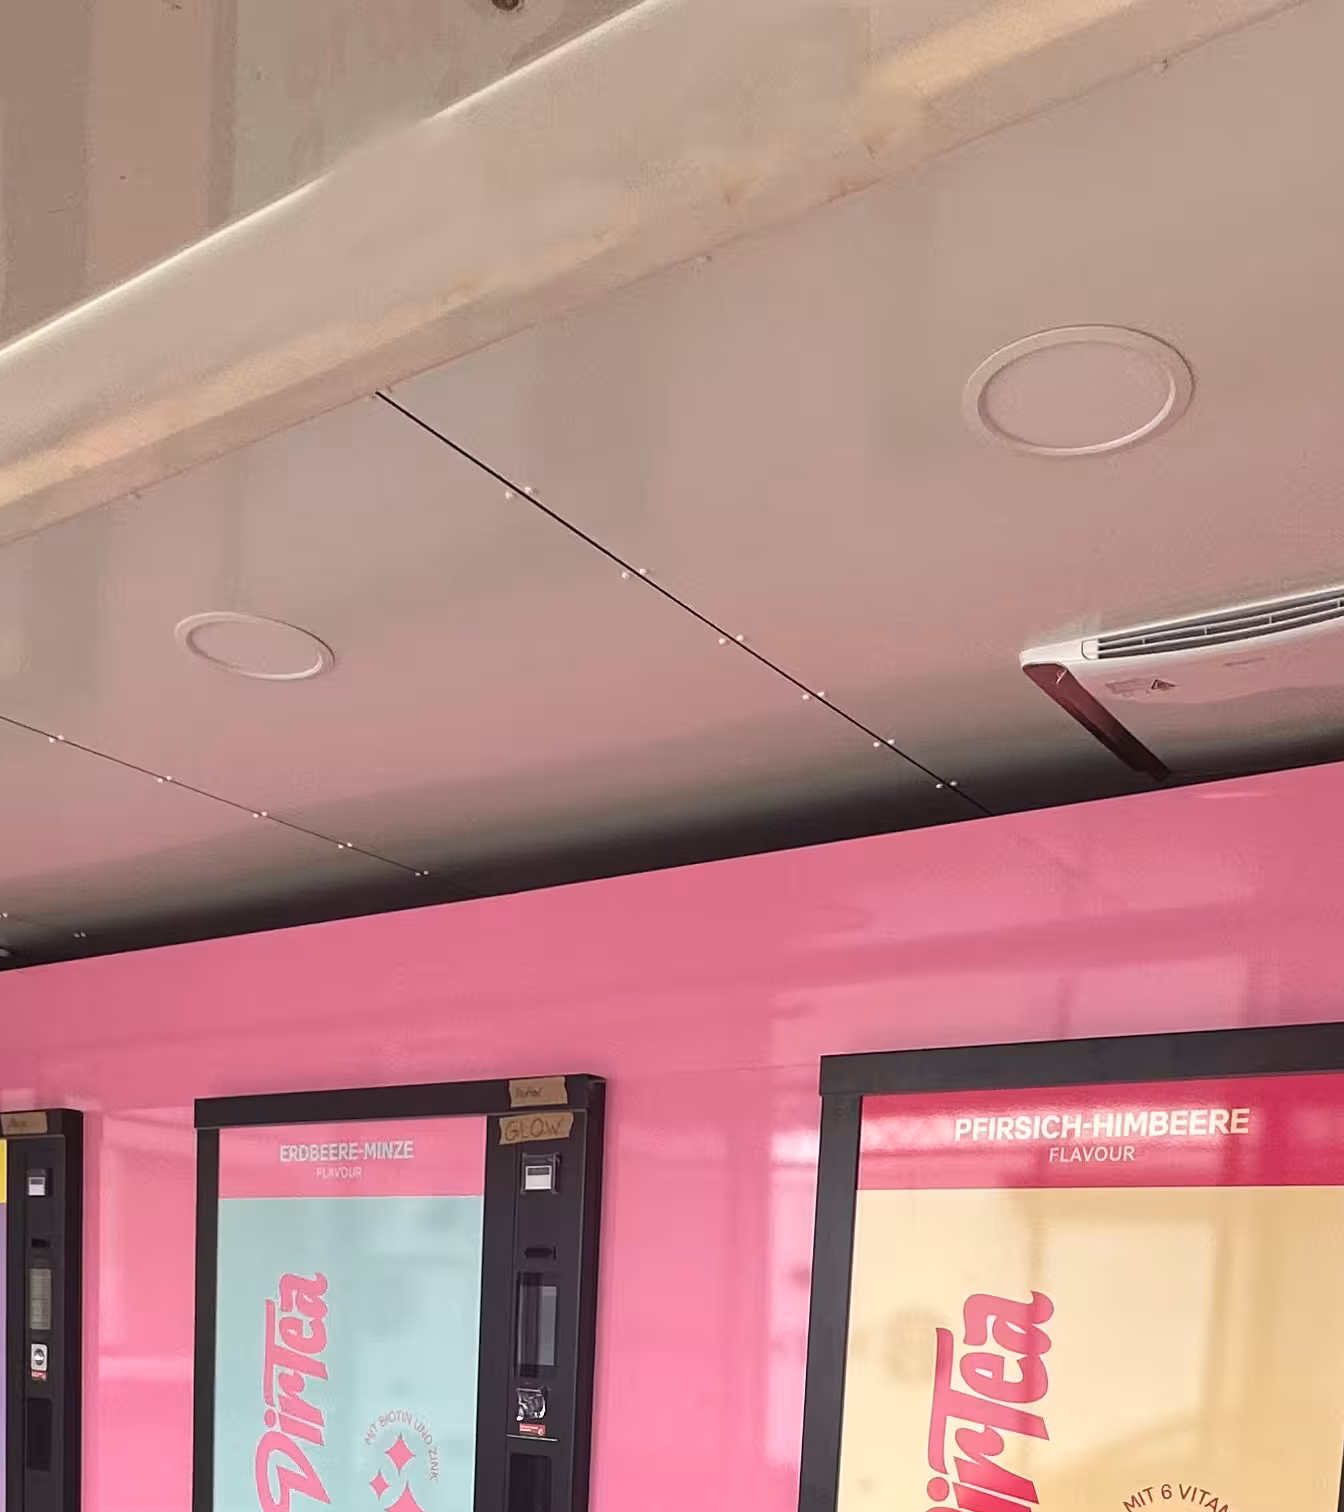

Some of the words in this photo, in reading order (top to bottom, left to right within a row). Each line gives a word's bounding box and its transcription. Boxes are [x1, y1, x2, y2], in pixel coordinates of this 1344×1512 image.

[505, 1116, 564, 1142] GLOW
[953, 1107, 1251, 1142] PFIRSICH-HIMBEERE
[280, 1140, 414, 1163] ERDBEERE-MINZE
[1048, 1144, 1136, 1163] FLAVOUR
[316, 1166, 362, 1180] FLAVOUR
[364, 1423, 379, 1446] MIT
[378, 1410, 413, 1427] BIOTIN
[413, 1417, 433, 1446] UND
[428, 1446, 440, 1481] ZINK
[1161, 1483, 1173, 1500] 6
